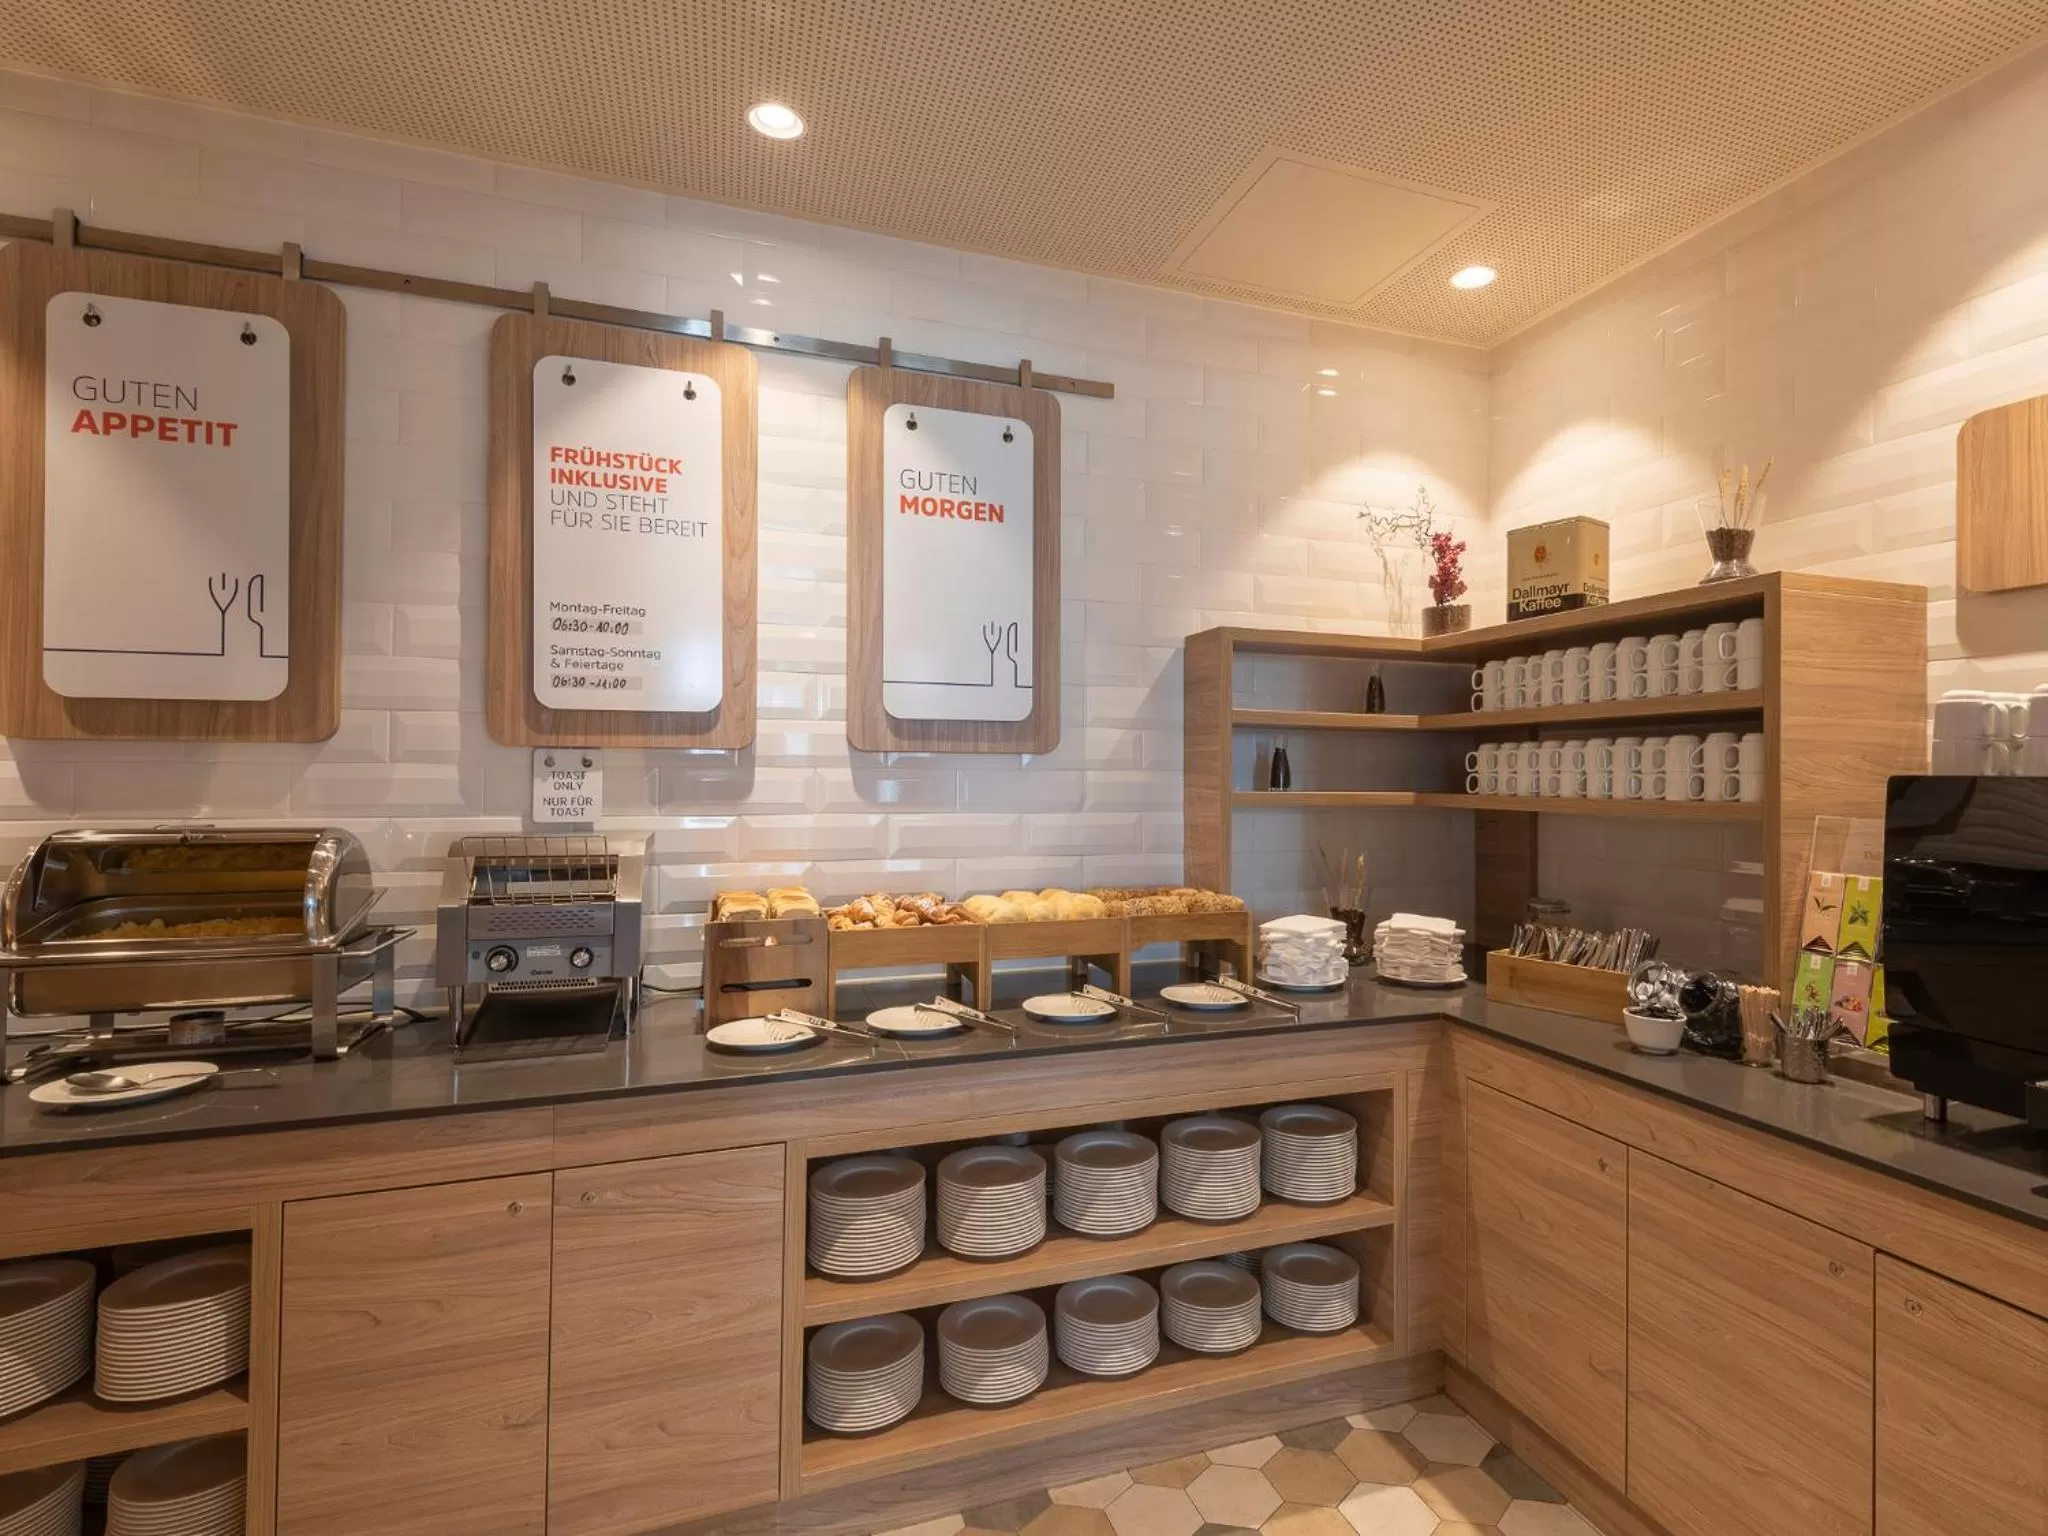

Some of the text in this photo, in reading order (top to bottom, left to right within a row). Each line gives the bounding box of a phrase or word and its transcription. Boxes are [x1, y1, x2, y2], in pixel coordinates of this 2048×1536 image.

[72, 374, 199, 412] GUTEN
[71, 408, 239, 448] APPETIT
[550, 445, 683, 475] FRÜHSTÜCK
[550, 467, 668, 494] INKLUSIVE
[900, 468, 977, 496] GUTEN
[550, 488, 669, 514] UND STEHT
[900, 494, 1005, 524] MORGEN
[550, 508, 709, 539] FÜR SIE BEREIT
[1512, 583, 1570, 600] Dallmayr
[550, 601, 646, 618] Montag-Freitag
[1520, 597, 1562, 613] Kaffee
[550, 644, 661, 661] Samstag-Sonntag
[550, 658, 625, 672] & Feiertage
[552, 771, 586, 780] TOAST
[553, 781, 583, 791] ONLY
[543, 795, 593, 806] NUR FÜR
[550, 807, 585, 817] TOAST
